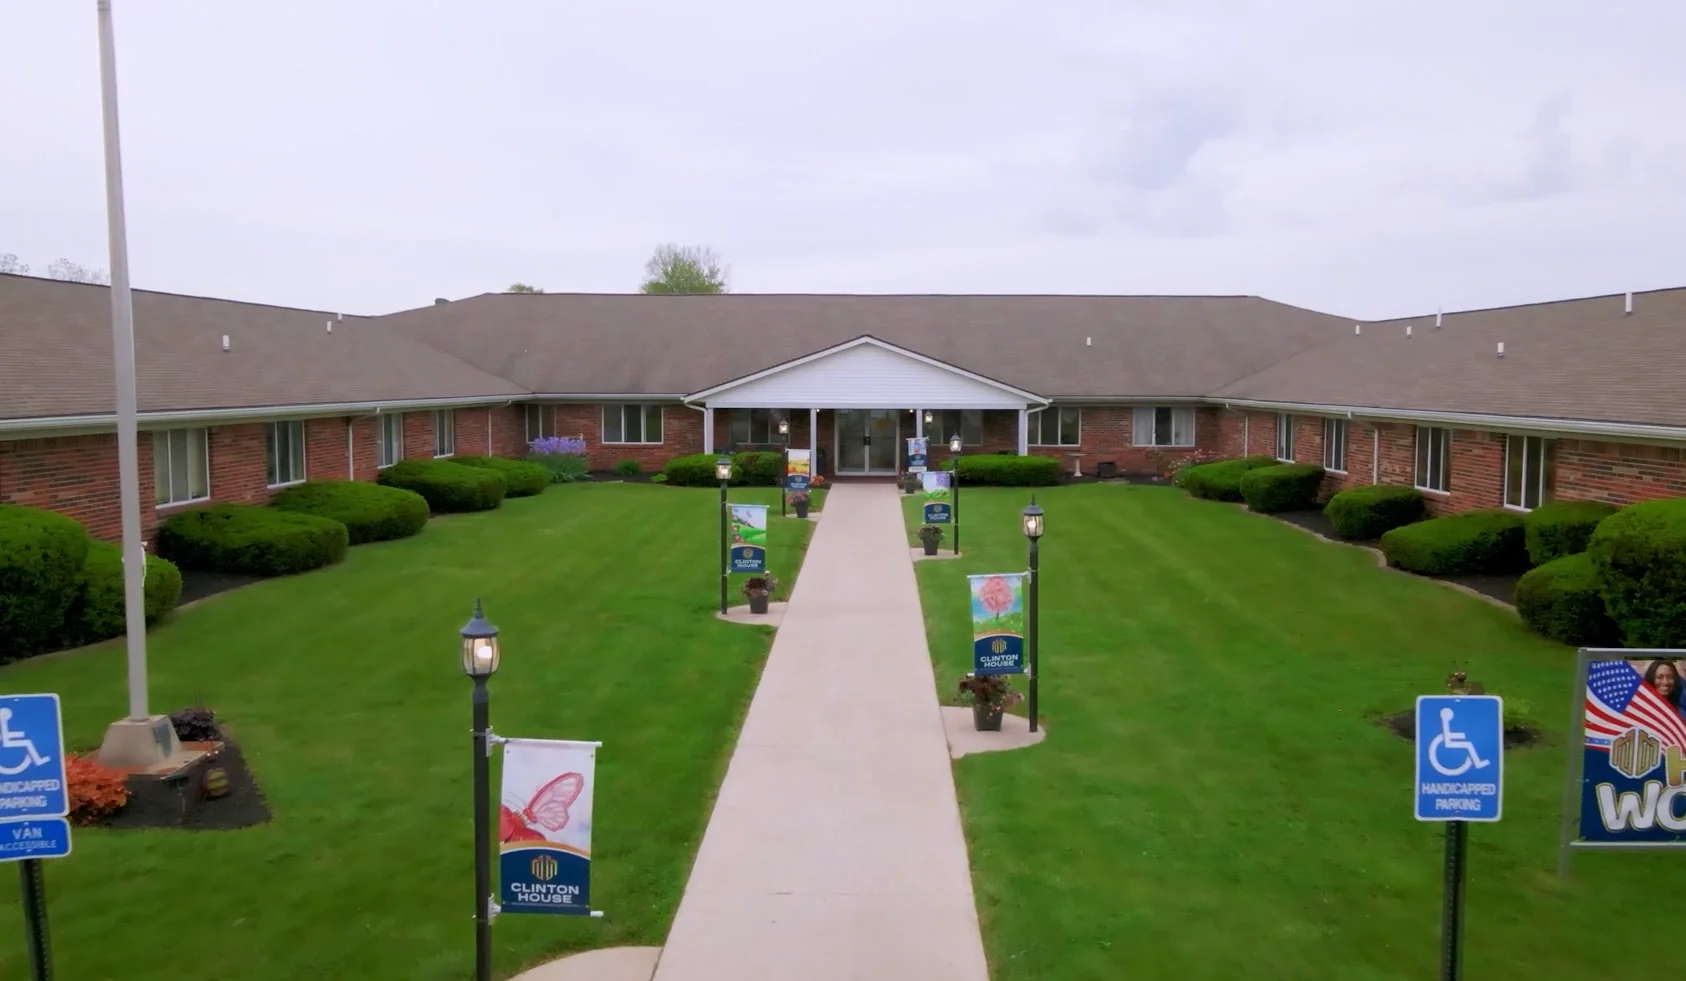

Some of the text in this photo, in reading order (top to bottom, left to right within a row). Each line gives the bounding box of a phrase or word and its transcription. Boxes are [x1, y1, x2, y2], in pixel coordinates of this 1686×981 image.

[980, 654, 1019, 662] CLINTON
[1422, 782, 1497, 795] HANDICAPPED
[1435, 798, 1482, 811] PARKING
[12, 827, 43, 840] VAN
[510, 882, 580, 895] CLINTON
[517, 892, 573, 904] HOUSE
